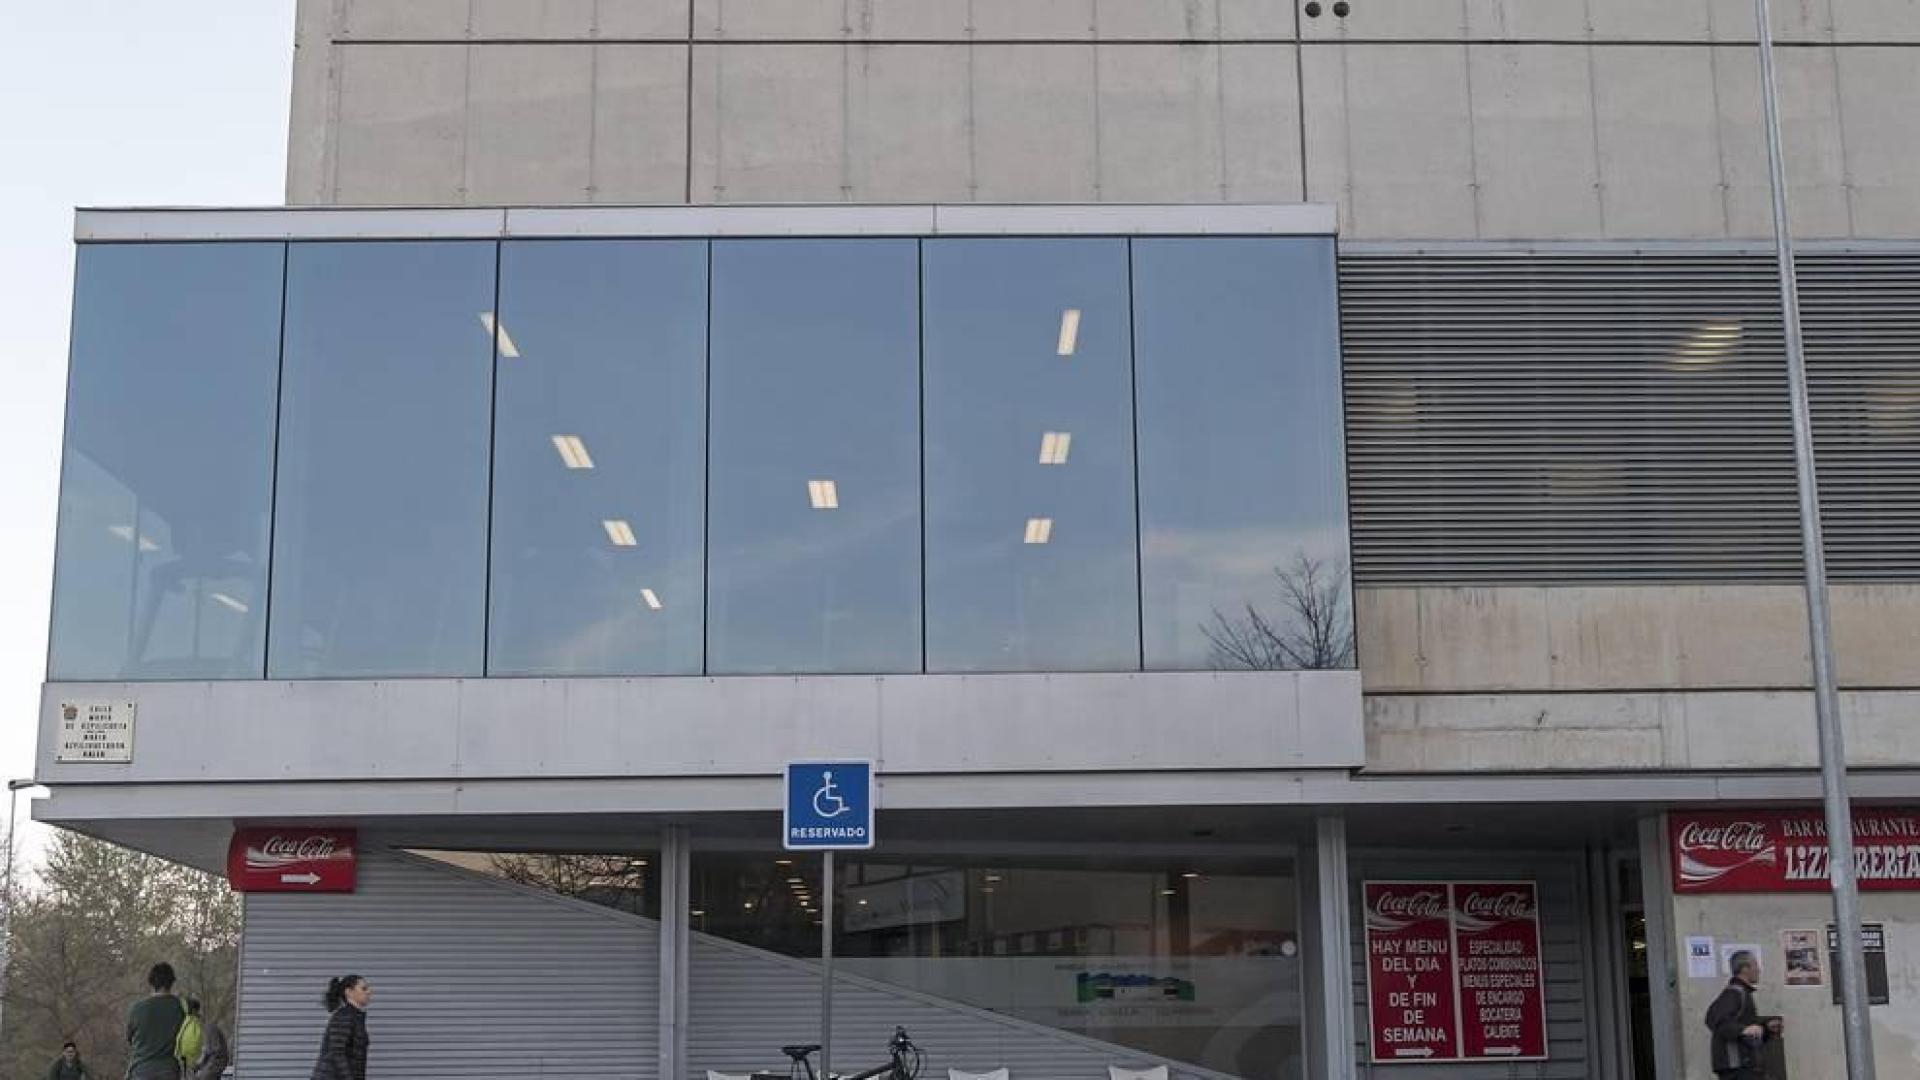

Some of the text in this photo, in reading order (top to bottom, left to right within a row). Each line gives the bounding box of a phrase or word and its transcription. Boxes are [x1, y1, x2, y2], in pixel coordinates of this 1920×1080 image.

[791, 827, 865, 838] RESERVADO
[1783, 817, 1919, 837] BAR RAURANTE
[1372, 939, 1449, 954] HAY MENU
[1469, 939, 1523, 955] ESPECIALIDAD
[1382, 957, 1441, 972] DEL DIA
[1459, 957, 1536, 972] PLATOS COMBINADOS
[1406, 974, 1417, 989] Y
[1462, 973, 1535, 988] MENUS ESPECIALES
[1389, 992, 1437, 1007] DE FIN
[1475, 990, 1524, 1005] DE ENCARGO
[1403, 1010, 1425, 1025] DE
[1383, 1027, 1448, 1042] SEMANA
